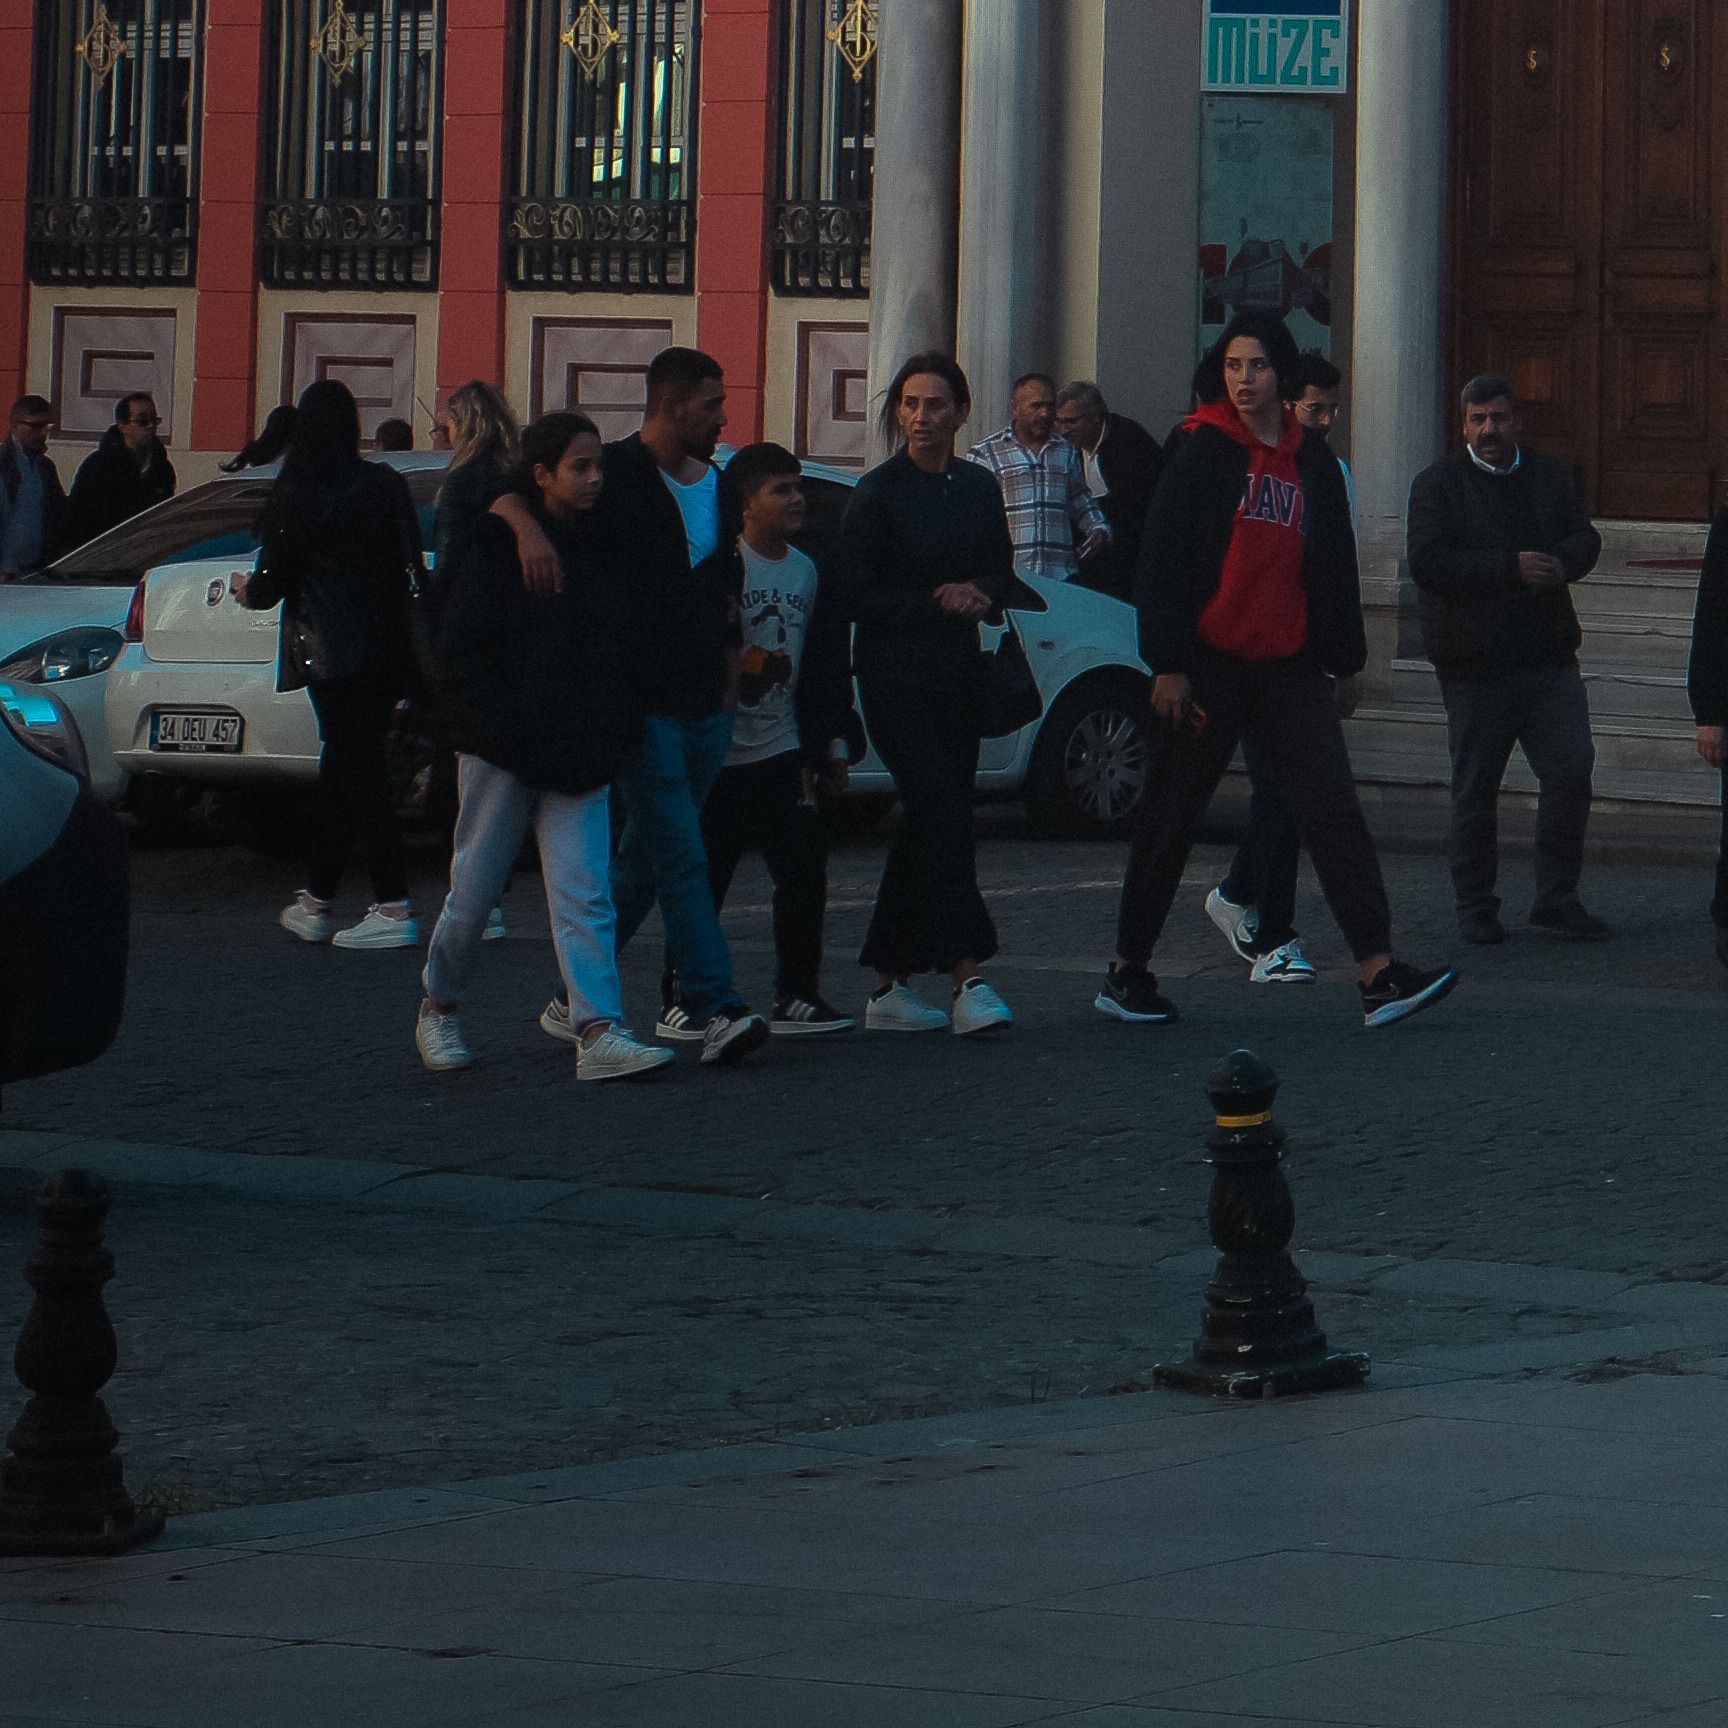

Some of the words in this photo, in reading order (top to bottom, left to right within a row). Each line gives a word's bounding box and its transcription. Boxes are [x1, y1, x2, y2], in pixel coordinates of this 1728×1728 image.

[1207, 17, 1340, 86] MÜZE
[159, 717, 175, 741] 34
[213, 718, 238, 743] 457
